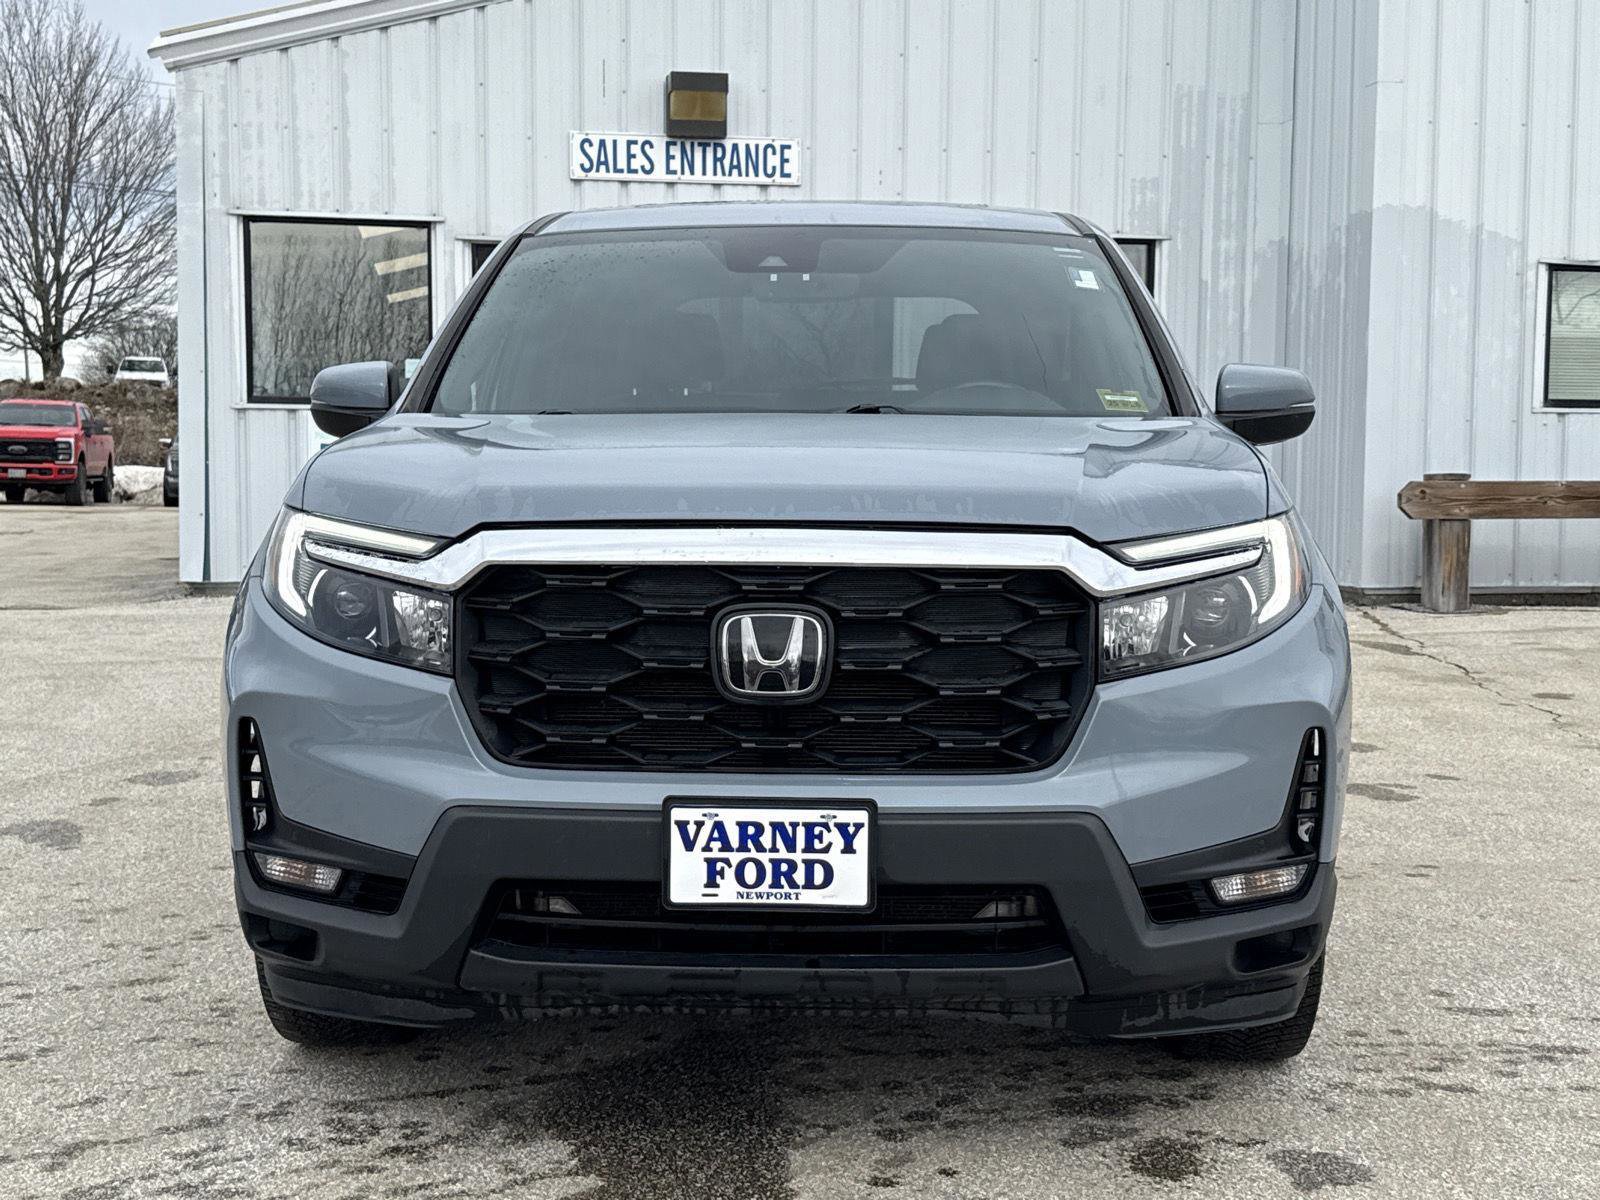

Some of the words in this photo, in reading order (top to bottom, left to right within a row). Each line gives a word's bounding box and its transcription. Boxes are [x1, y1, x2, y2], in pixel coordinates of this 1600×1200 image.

[579, 137, 655, 175] SALES
[665, 140, 792, 179] ENTRANCE
[674, 819, 865, 855] VARNEY
[703, 856, 835, 890] FORD
[736, 890, 802, 901] NEWPORT
